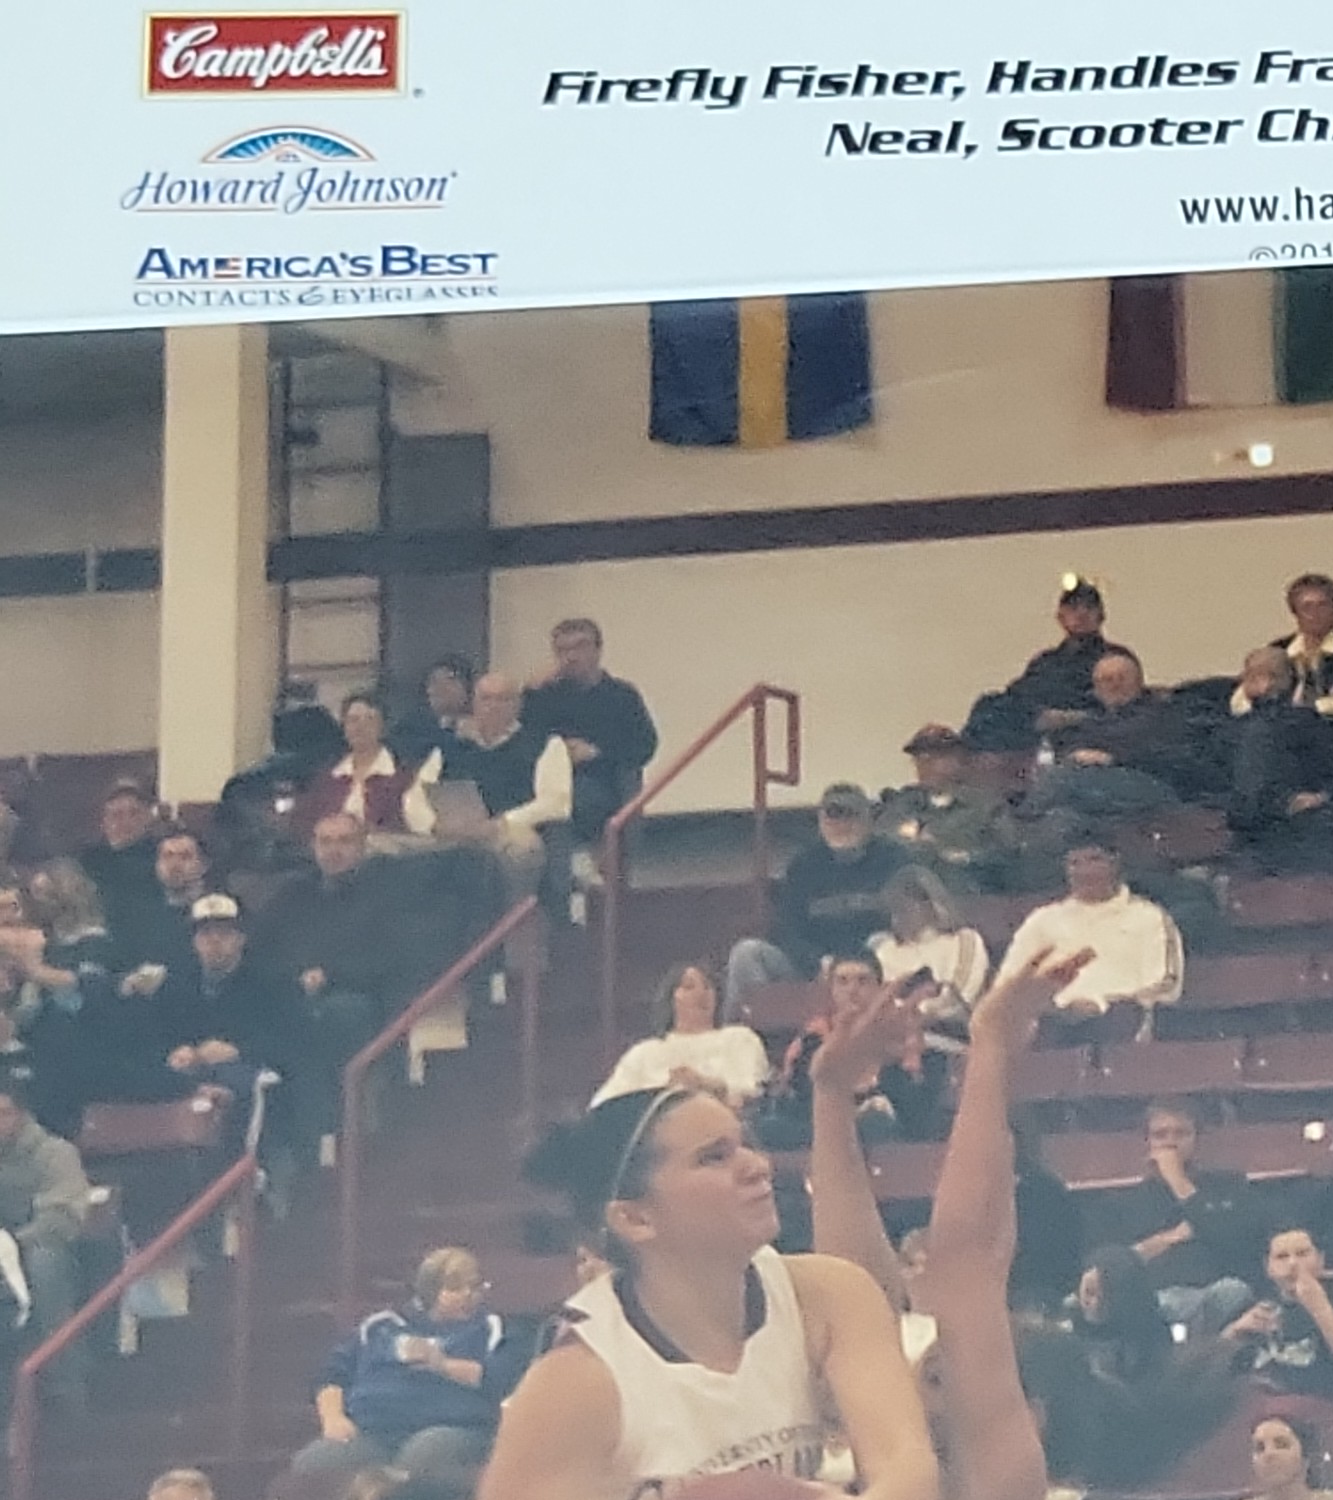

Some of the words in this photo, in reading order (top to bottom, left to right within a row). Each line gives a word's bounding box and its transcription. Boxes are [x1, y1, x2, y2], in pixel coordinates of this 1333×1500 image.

[542, 67, 748, 110] Firefly
[762, 64, 967, 99] Fisher,
[986, 55, 1240, 95] Handles
[825, 120, 979, 159] Neal,
[997, 117, 1244, 152] Scooter
[120, 171, 284, 210] Howard
[134, 288, 292, 307] CONTACTS
